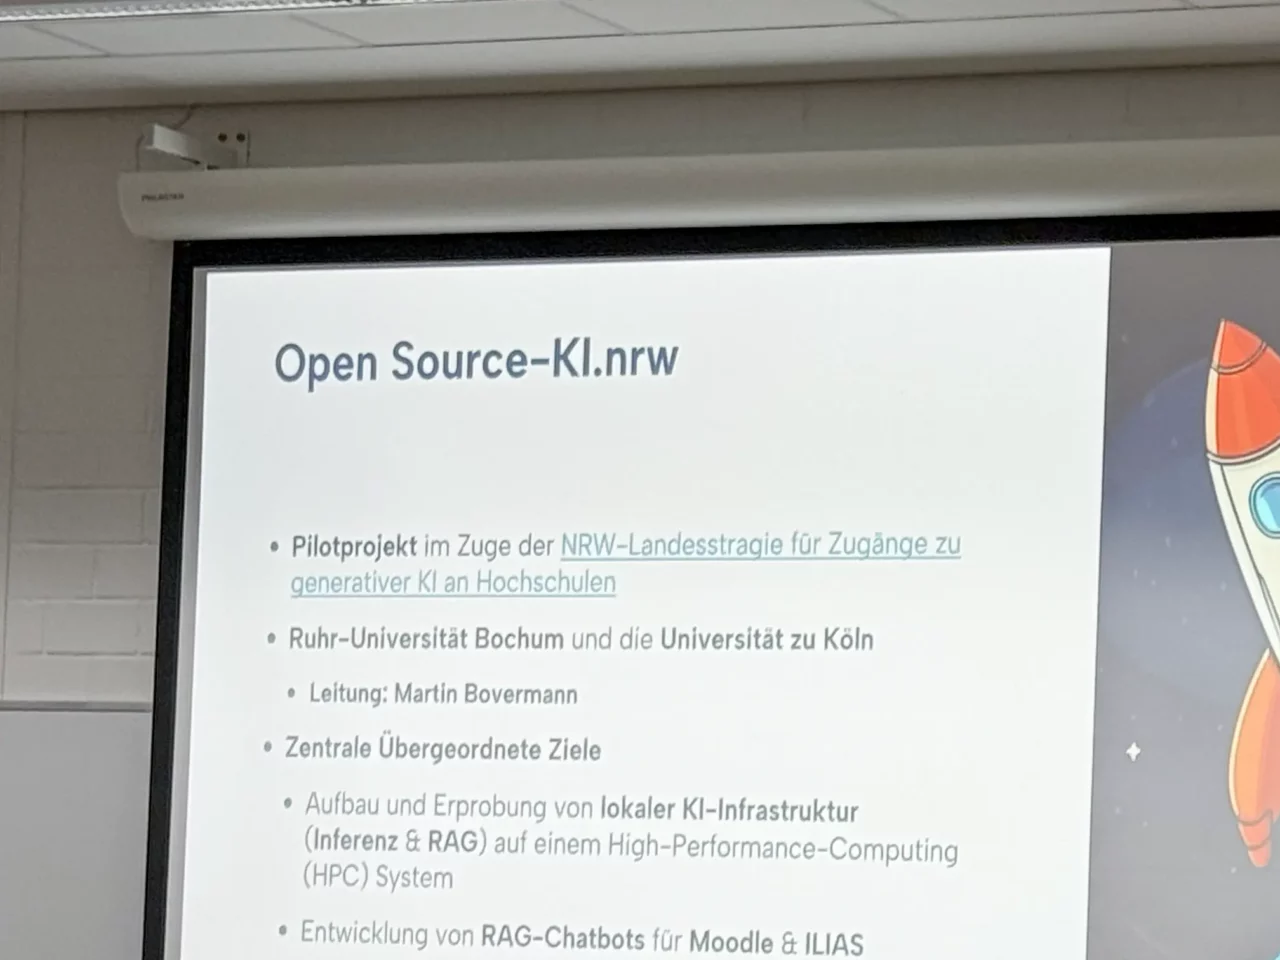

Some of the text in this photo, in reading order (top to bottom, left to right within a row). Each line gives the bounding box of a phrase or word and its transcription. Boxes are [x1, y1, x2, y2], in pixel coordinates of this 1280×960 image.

[275, 337, 679, 392] Open Source-KI.nrw
[293, 530, 961, 563] Pilotprojekt im Zuge der NRW-Landesstragie für Zugänge zu
[291, 568, 616, 596] generativer KI an Hochschulen
[290, 626, 873, 650] Ruhr-Universität Bochum und die Universität zu Köln
[310, 682, 577, 708] Leitung: Martin Bovermann
[286, 730, 601, 765] Zentrale Übergeordnete Ziele
[305, 791, 859, 824] Aufbau und Erprobung von lokaler KI-Infrastruktur
[305, 825, 958, 868] (Inferenz & RAG) auf einem High-Performance-Computing
[304, 860, 453, 893] (HPC) System
[301, 919, 863, 956] Entwicklung von RAG-Chatbots für Moodle & ILIAS
